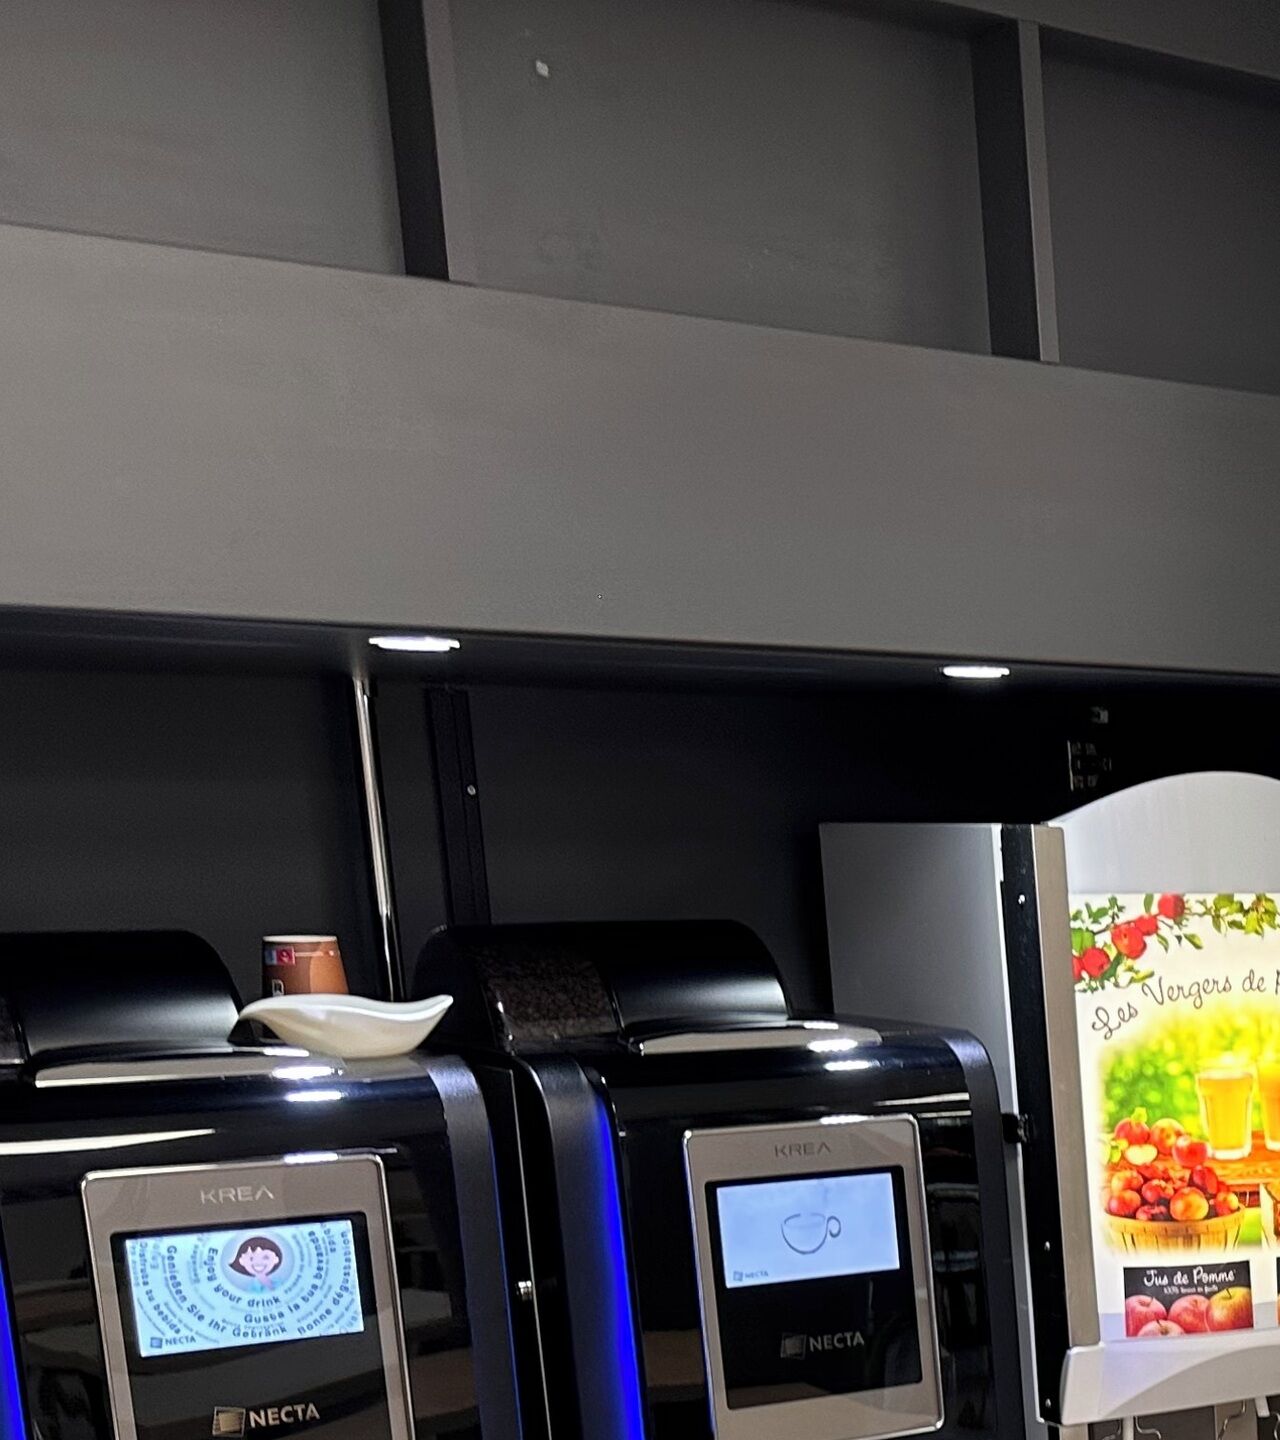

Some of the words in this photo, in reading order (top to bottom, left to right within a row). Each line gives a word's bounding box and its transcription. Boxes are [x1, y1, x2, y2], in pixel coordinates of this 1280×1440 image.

[1092, 1003, 1139, 1040] Les
[1141, 975, 1233, 1010] Vergers
[1241, 969, 1267, 993] de
[774, 1142, 832, 1157] KREA
[200, 1184, 275, 1204] KREA
[203, 1247, 219, 1284] Enjoy
[213, 1282, 243, 1305] your
[247, 1296, 281, 1309] drink
[296, 1308, 333, 1335] Bonne
[332, 1230, 352, 1307] dégustation
[1144, 1269, 1168, 1287] Jus
[1173, 1271, 1189, 1285] de
[1192, 1266, 1235, 1284] Pomme
[166, 1245, 188, 1304] Genießen
[187, 1304, 206, 1322] Sie
[208, 1318, 228, 1334] Ihr
[232, 1325, 288, 1339] Getränk
[153, 1303, 182, 1335] bebida
[244, 1311, 285, 1324] Gusta
[287, 1302, 302, 1315] la
[165, 1336, 197, 1346] NECTA
[808, 1331, 865, 1352] NECTA
[248, 1402, 320, 1428] NECTA
